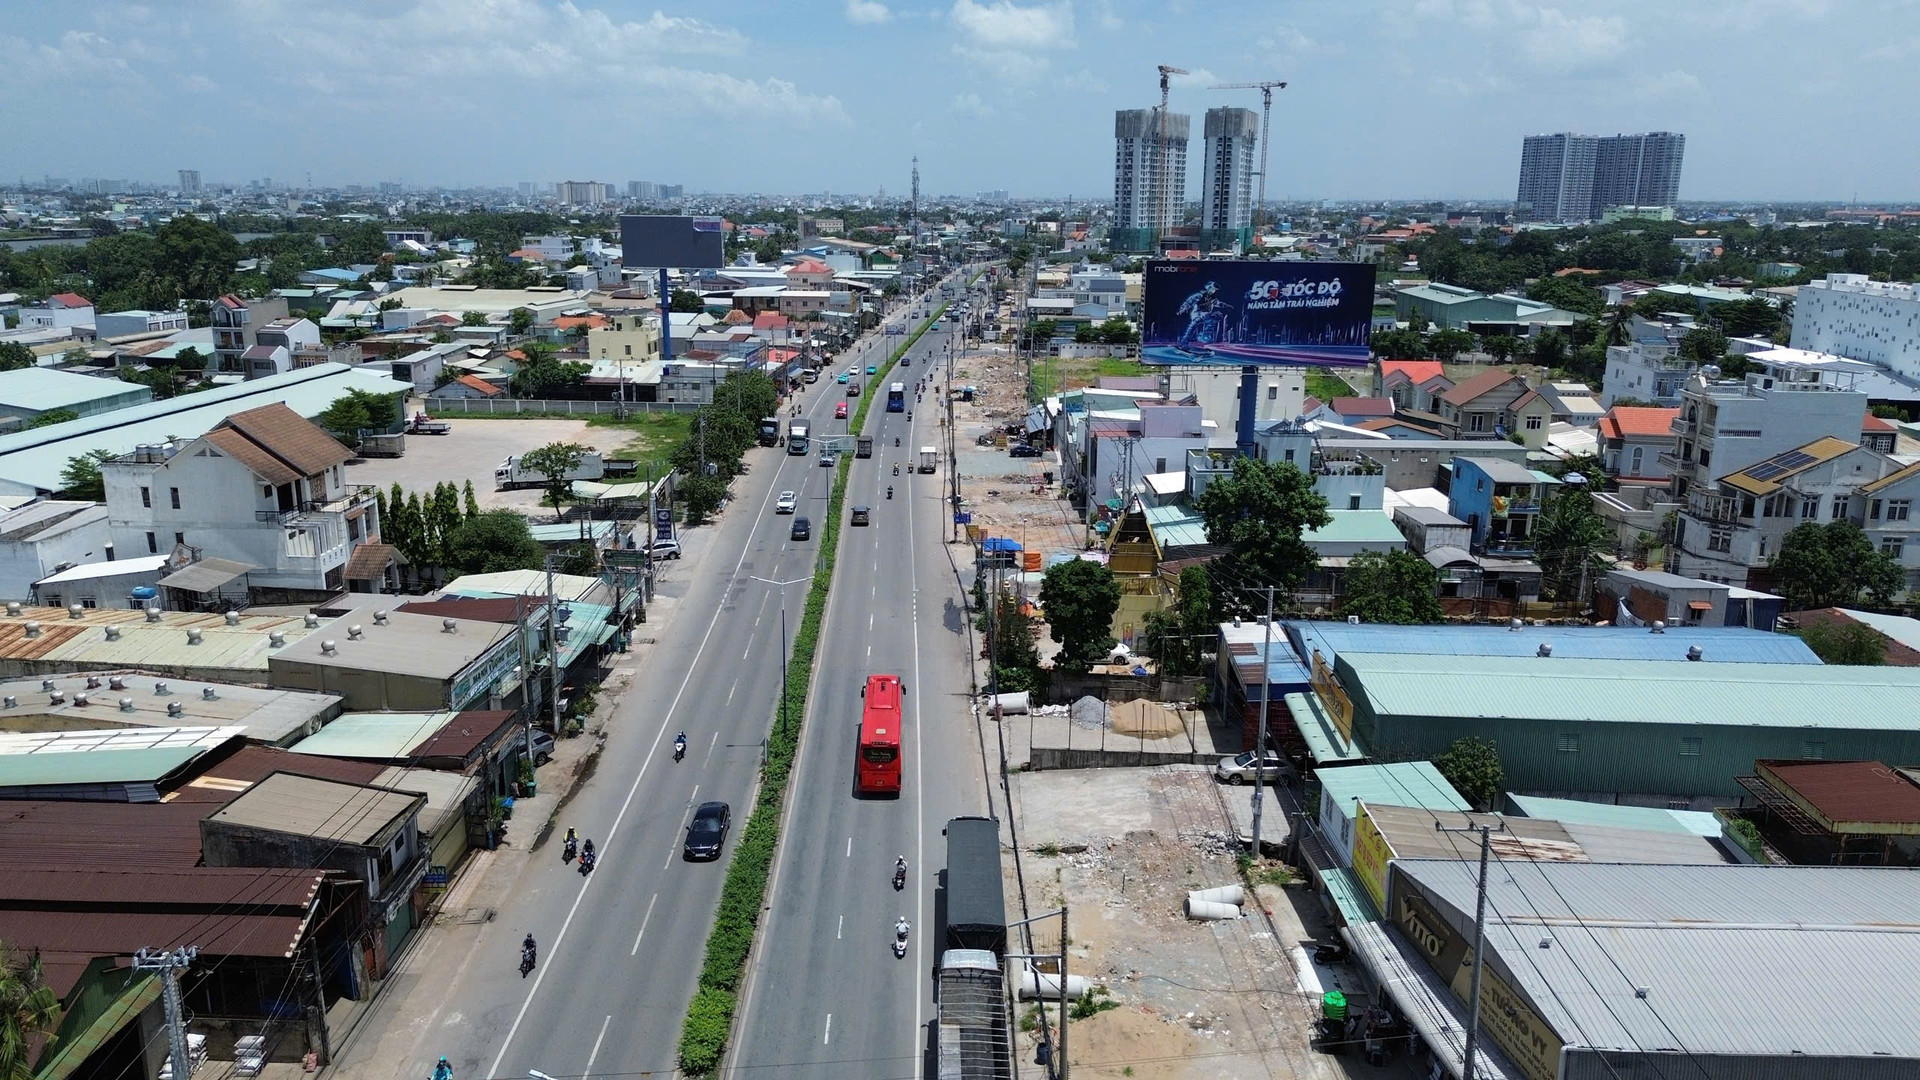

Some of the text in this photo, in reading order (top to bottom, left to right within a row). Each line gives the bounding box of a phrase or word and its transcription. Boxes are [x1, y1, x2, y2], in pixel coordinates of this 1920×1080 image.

[1250, 277, 1342, 300] 5G TỐC ĐỘ
[1305, 296, 1340, 308] NGHIỆM
